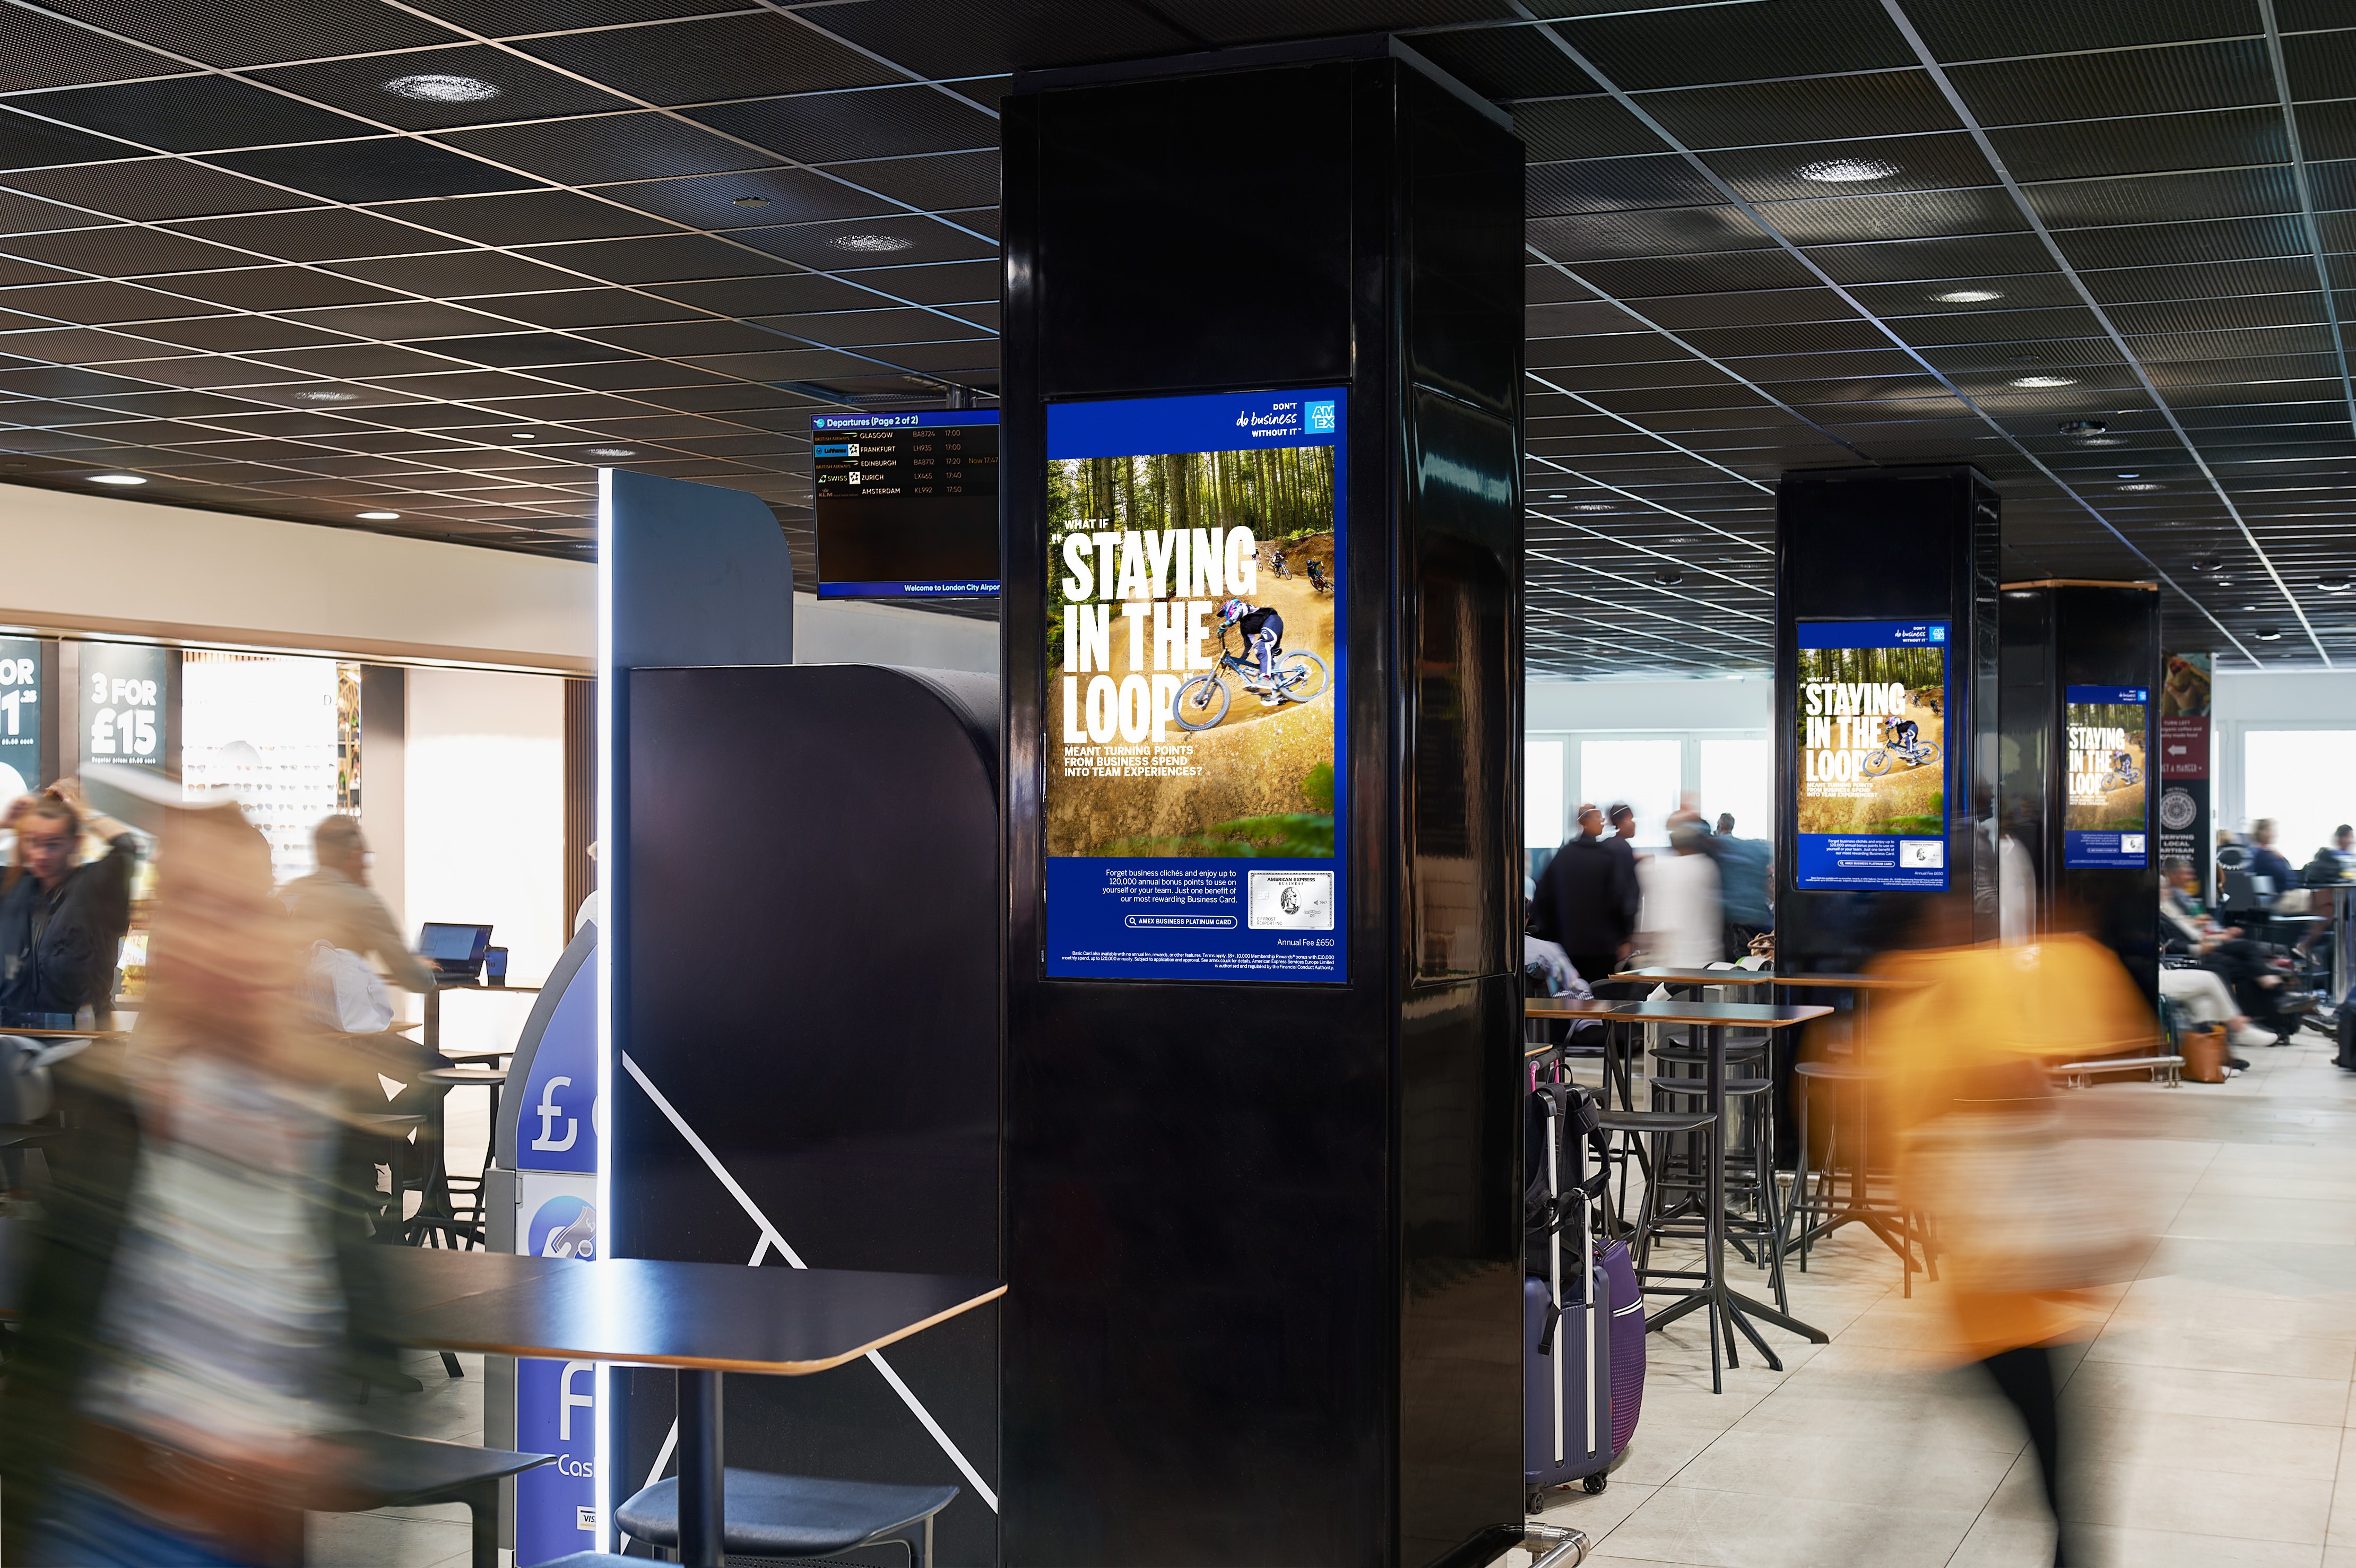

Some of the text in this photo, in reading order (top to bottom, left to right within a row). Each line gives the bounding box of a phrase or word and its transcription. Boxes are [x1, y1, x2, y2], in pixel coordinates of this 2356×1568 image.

[1273, 402, 1297, 411] DON'T
[827, 419, 870, 428] Departures
[871, 418, 894, 426] (Page
[902, 416, 910, 425] of
[910, 415, 919, 425] 2)
[1236, 410, 1297, 427] do business
[1252, 429, 1287, 438] WITHOUT
[1064, 519, 1108, 530] WHAT IF
[967, 583, 979, 592] City
[1063, 601, 1212, 673] IN THE
[91, 672, 157, 706] 3 FOR
[91, 708, 157, 755] £15
[1806, 716, 1883, 749] IN THE
[1064, 746, 1193, 756] MEANT TURNING POINTS
[1064, 756, 1188, 767] FROM BUSINESS SPEND
[2069, 750, 2112, 773] IN THE
[1064, 766, 1202, 777] INTO TEAM EXPERIENCES?
[532, 1076, 577, 1151] £
[558, 1453, 595, 1478] Cas
[583, 1514, 596, 1523] VIS
